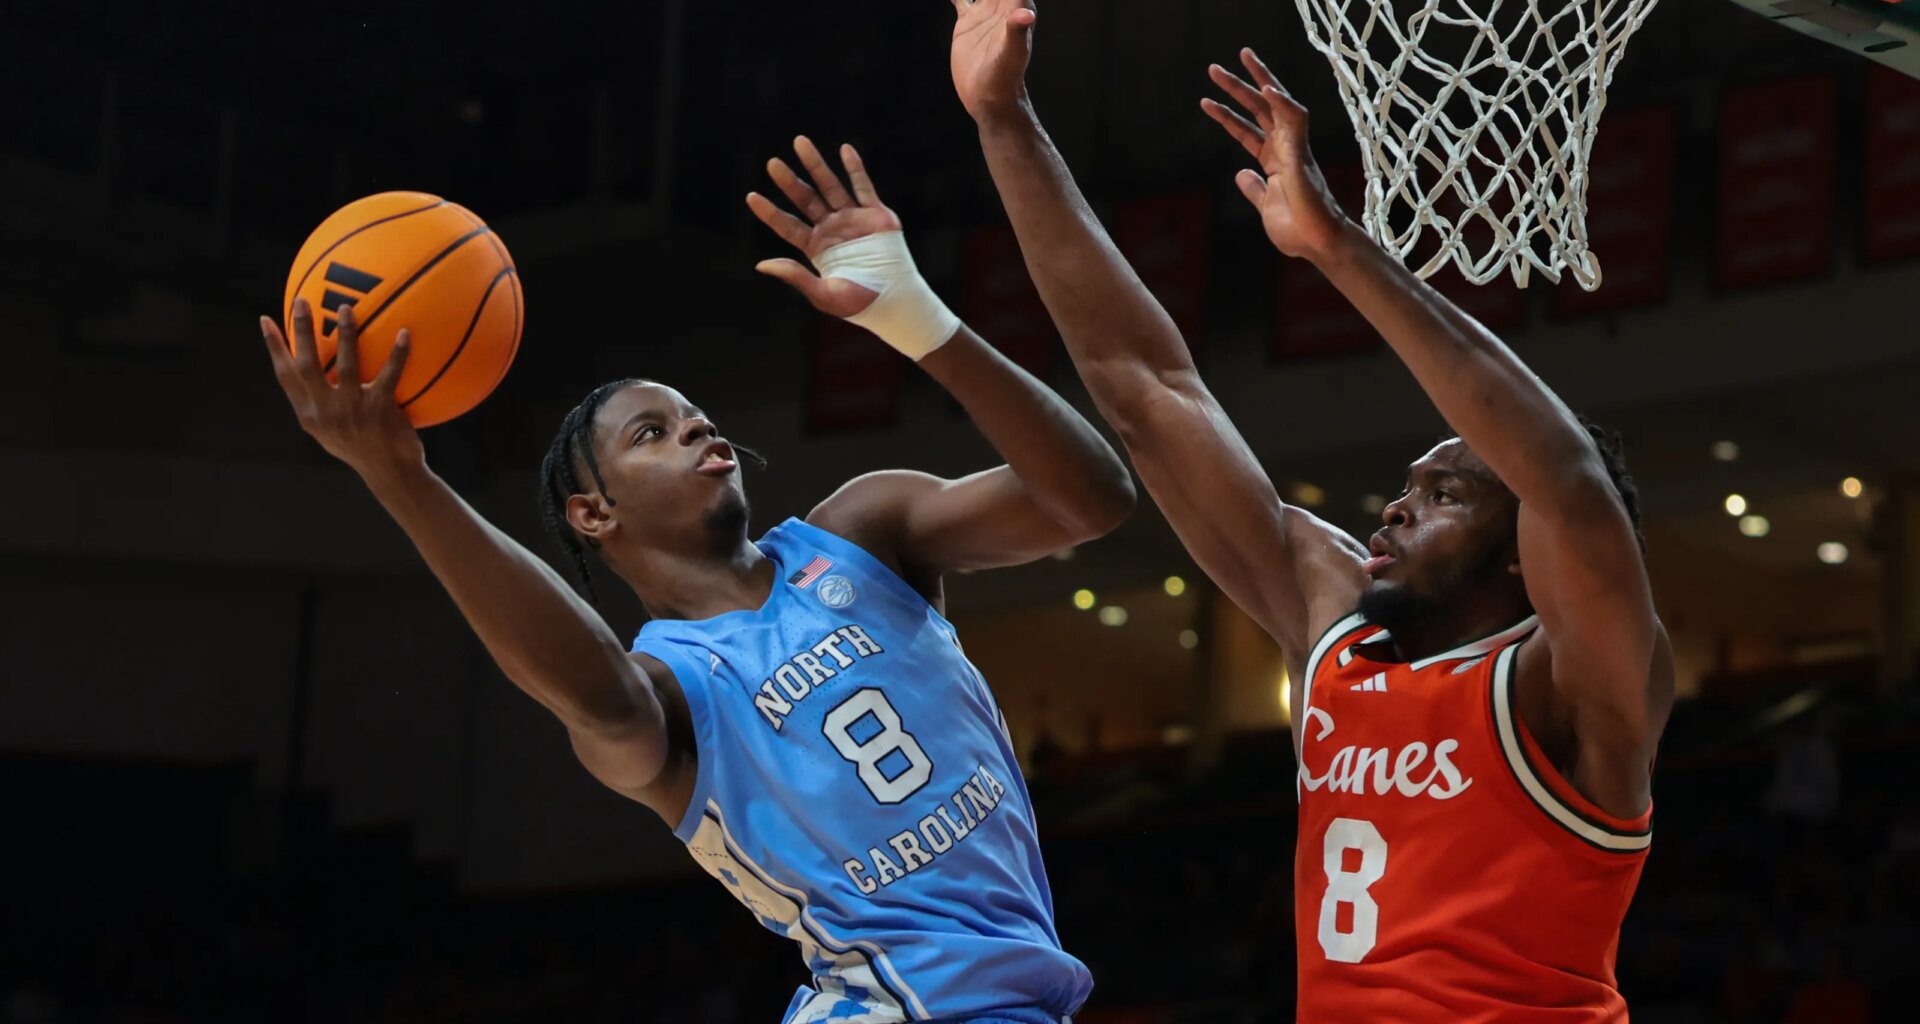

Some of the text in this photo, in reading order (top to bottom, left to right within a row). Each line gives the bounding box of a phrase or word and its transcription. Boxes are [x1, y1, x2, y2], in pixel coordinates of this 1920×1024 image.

[755, 624, 884, 732] NORTH
[823, 687, 934, 805] 8
[1299, 707, 1472, 800] Canes
[844, 765, 1006, 896] CAROLINA
[1318, 818, 1388, 964] 8
